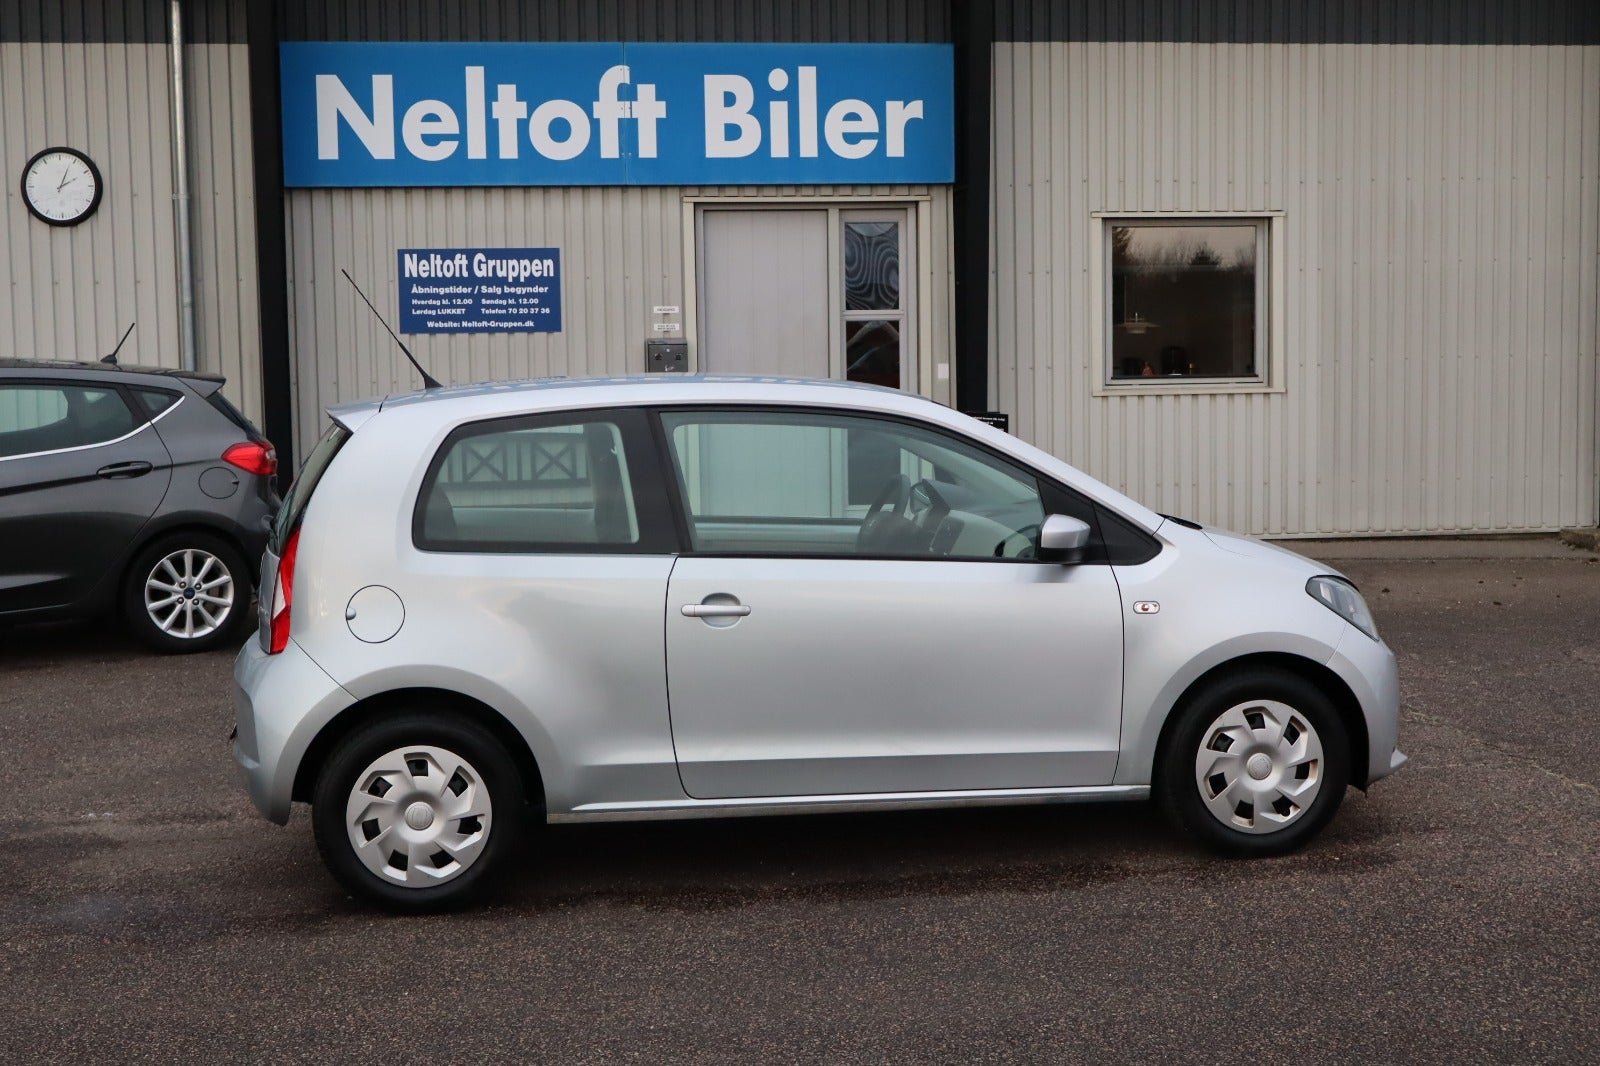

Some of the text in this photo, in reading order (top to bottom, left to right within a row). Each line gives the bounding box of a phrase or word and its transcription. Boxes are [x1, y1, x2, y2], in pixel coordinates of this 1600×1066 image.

[315, 65, 924, 161] Neltoft Biler
[404, 252, 555, 282] Neltoft Gruppen
[411, 284, 472, 295] Åbningstider
[481, 285, 502, 295] Salg
[503, 285, 549, 295] begynder
[411, 298, 441, 306] Hverdag
[481, 297, 507, 305] Søndag
[412, 308, 437, 316] Lørdag
[427, 320, 535, 328] Website: Neltoft-Gruppen.dk
